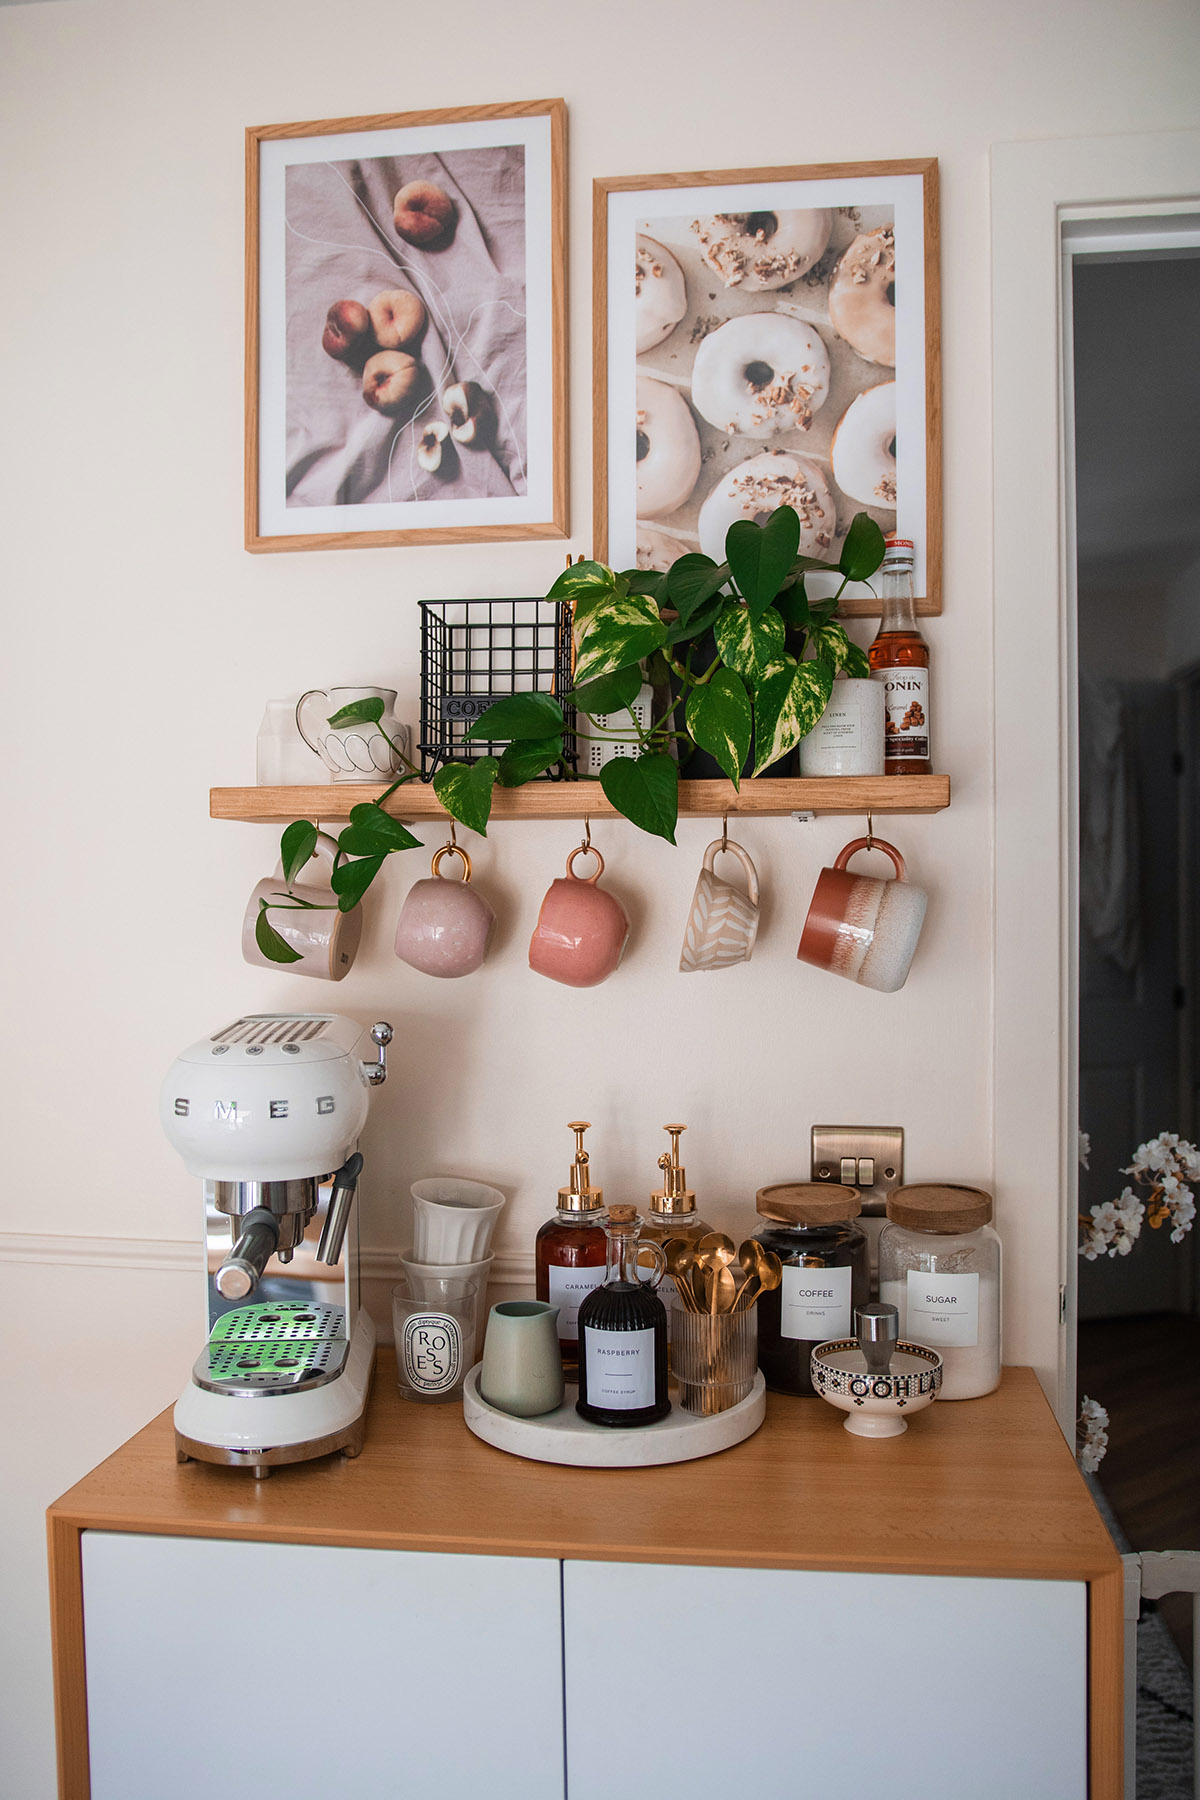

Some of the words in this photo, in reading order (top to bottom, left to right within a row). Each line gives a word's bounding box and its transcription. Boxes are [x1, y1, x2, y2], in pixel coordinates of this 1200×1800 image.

[884, 681, 921, 691] ONIN
[446, 700, 500, 717] COF
[174, 1096, 335, 1119] SMEG
[798, 1289, 834, 1298] COFFEE
[925, 1295, 957, 1304] SUGAR
[597, 1348, 640, 1356] RASPBERRY
[848, 1379, 910, 1398] OOH
[918, 1375, 937, 1394] LA
